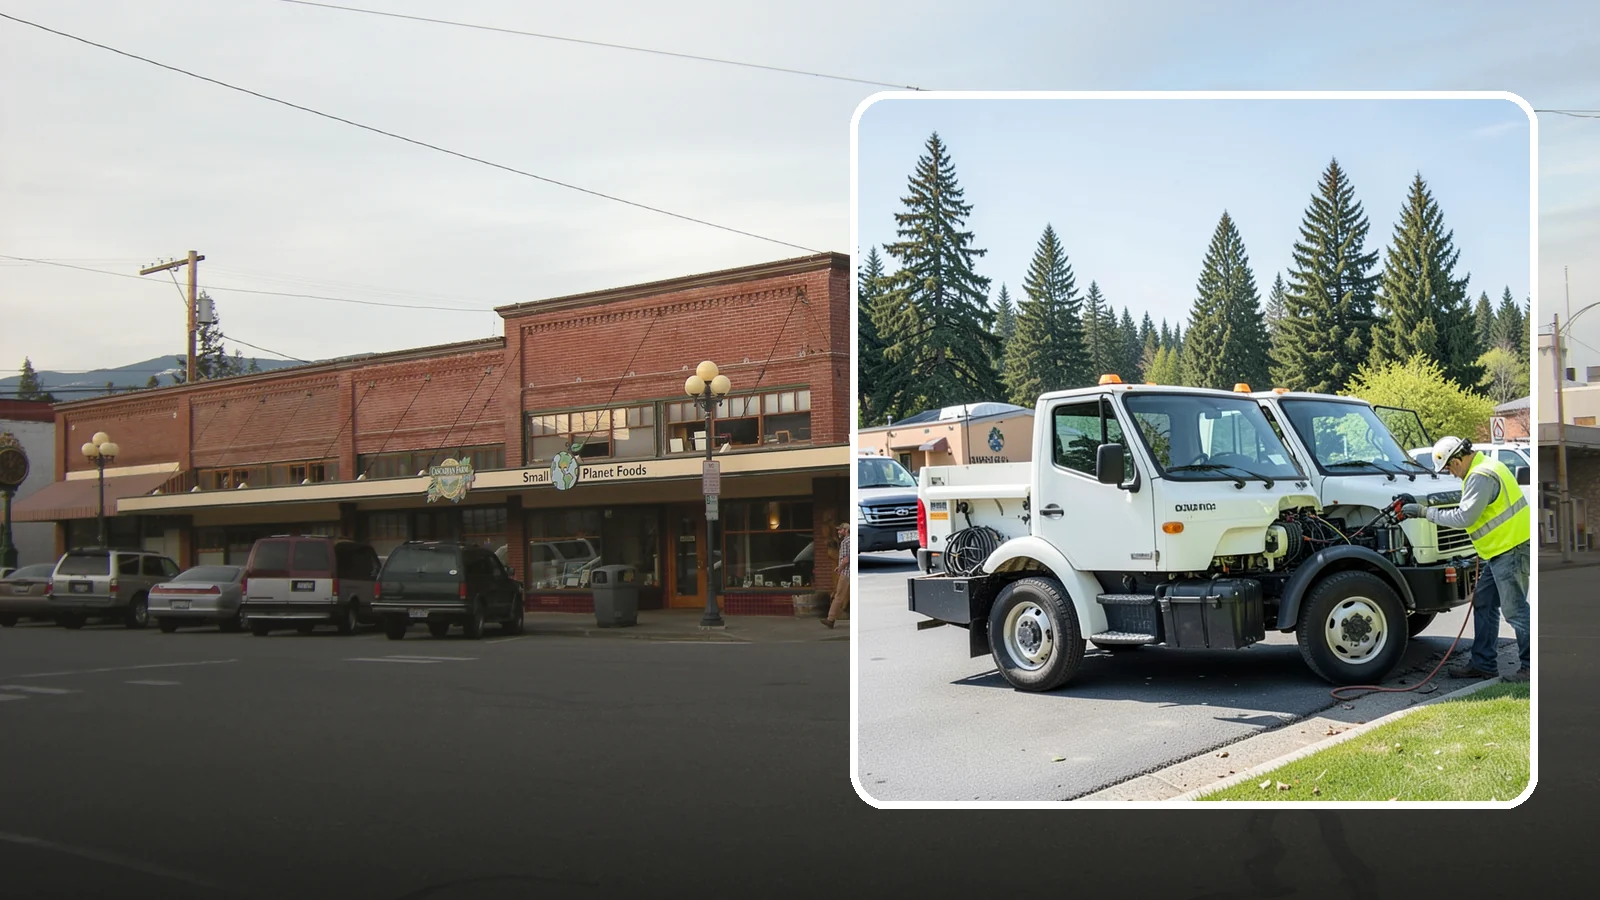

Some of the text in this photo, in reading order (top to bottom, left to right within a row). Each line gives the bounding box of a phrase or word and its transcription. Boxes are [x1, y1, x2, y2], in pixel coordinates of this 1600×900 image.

[523, 464, 647, 483] Small Planet Foods
